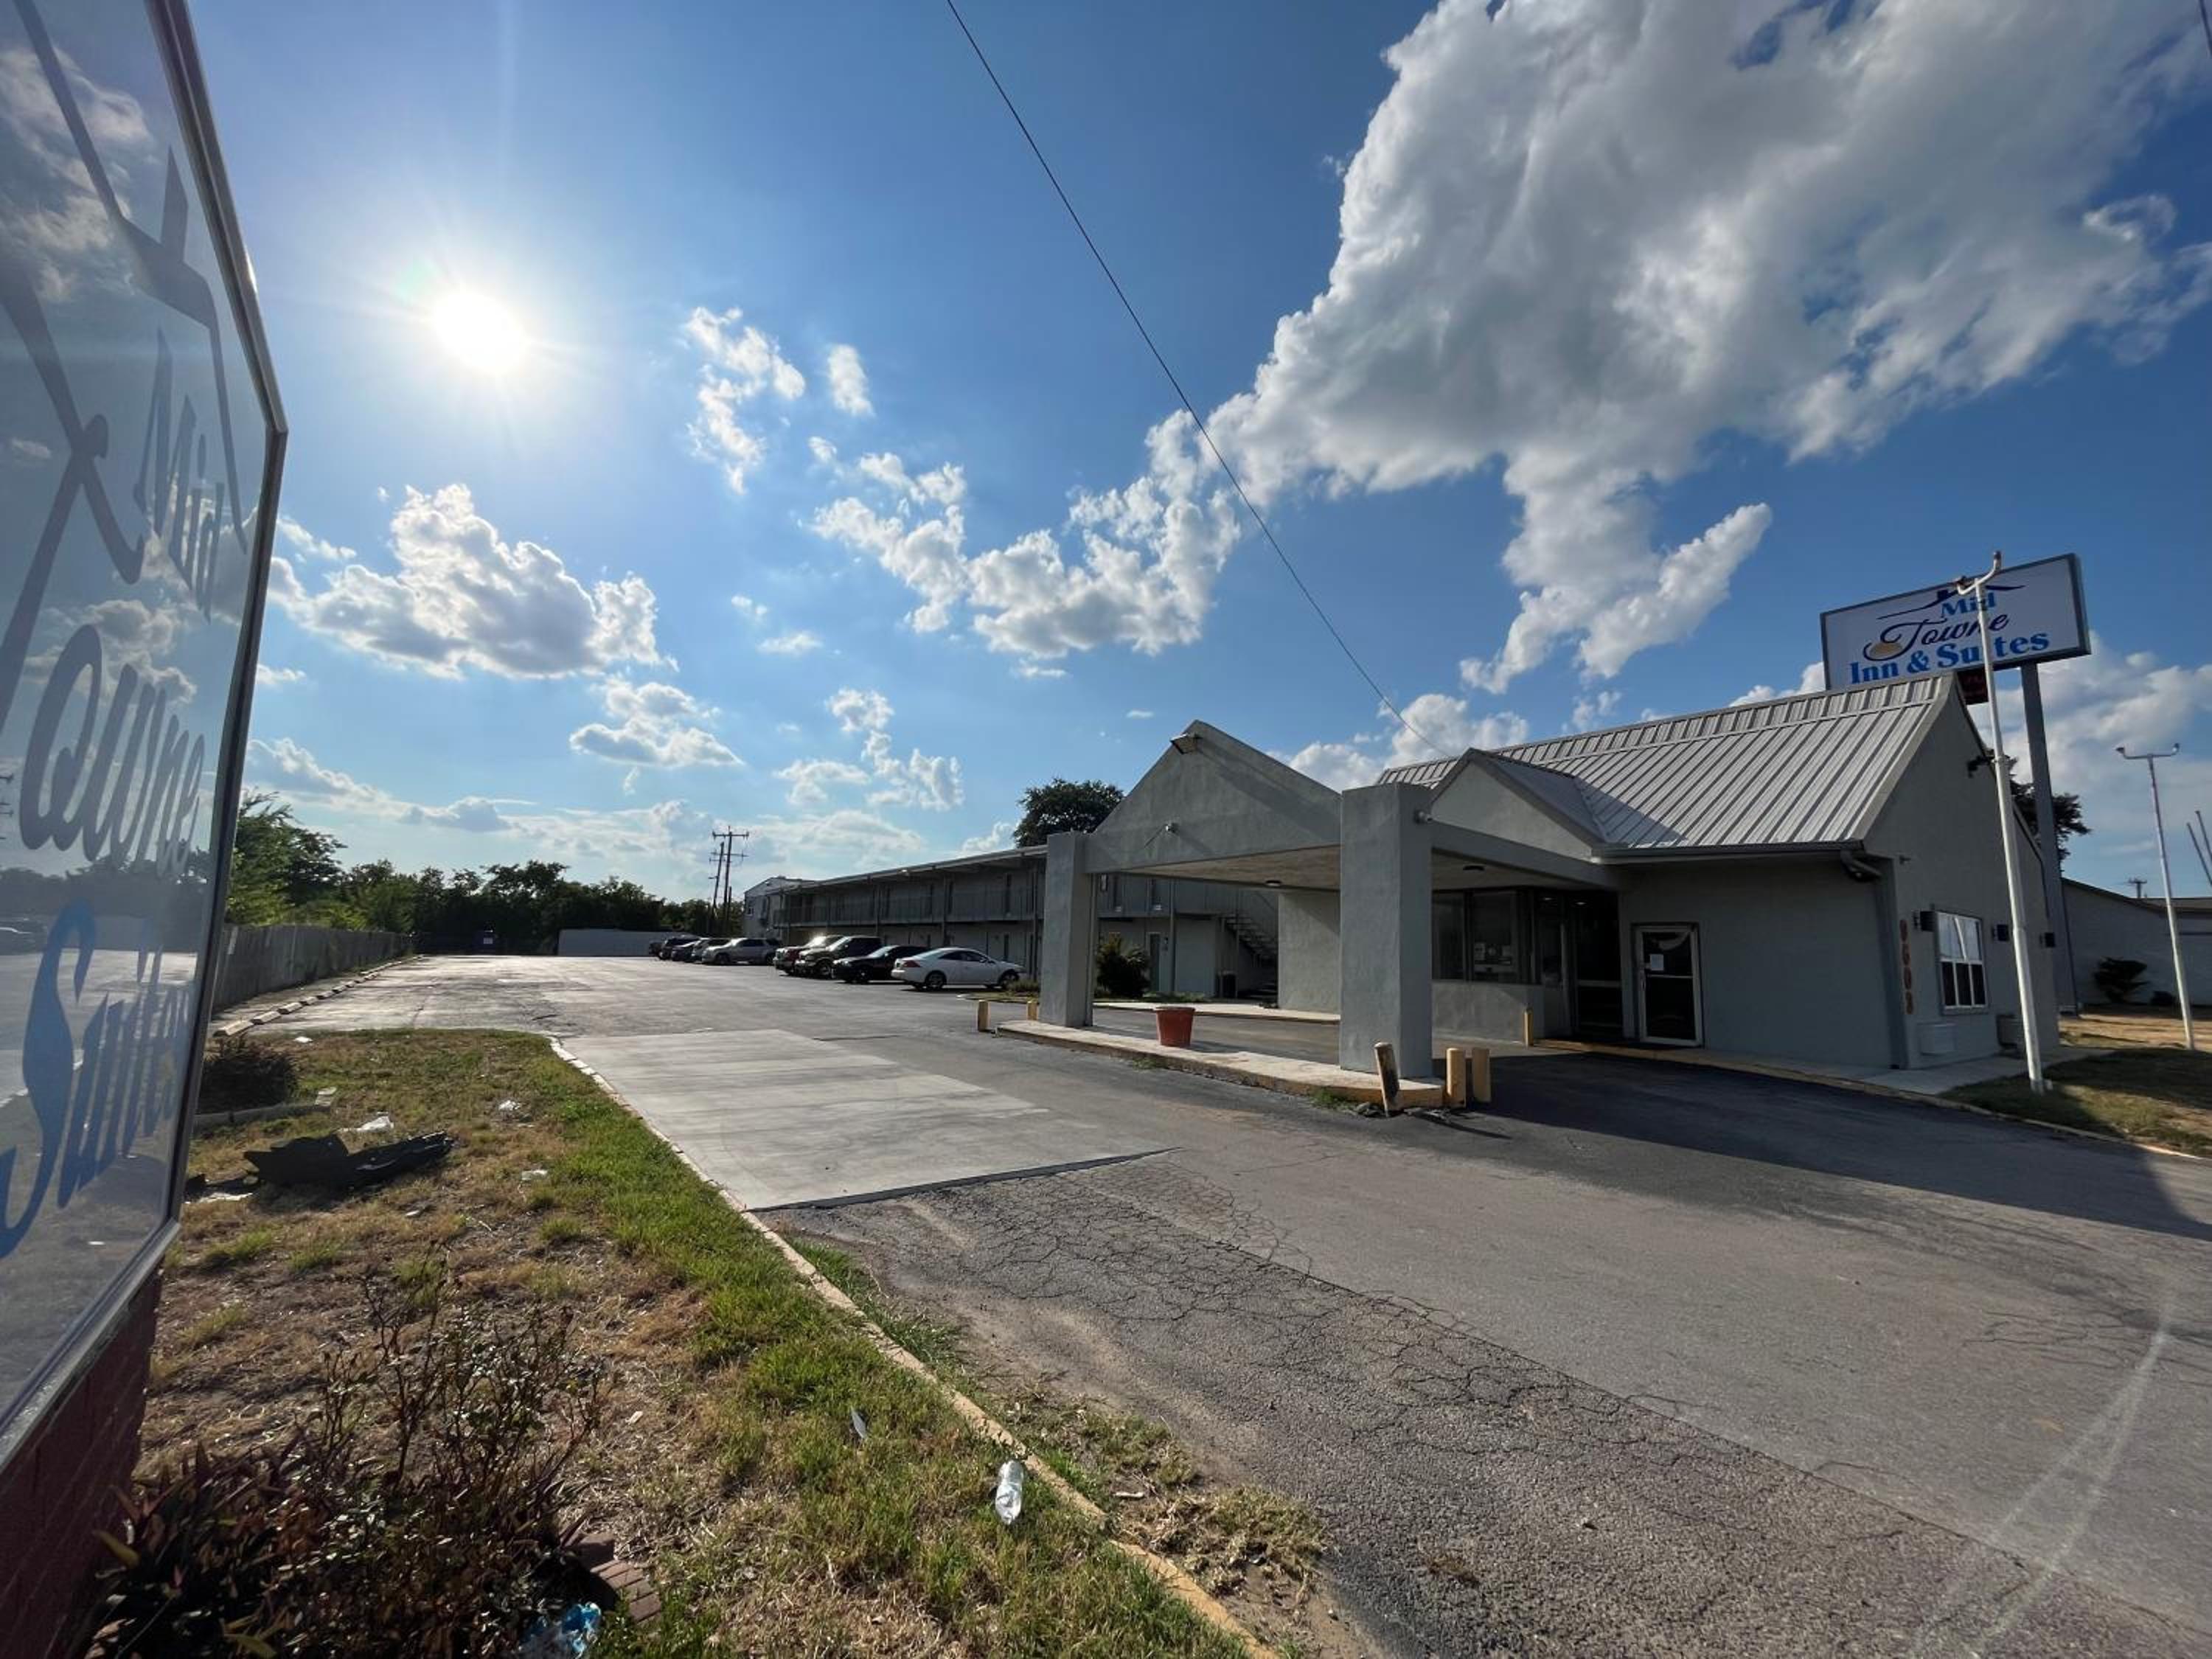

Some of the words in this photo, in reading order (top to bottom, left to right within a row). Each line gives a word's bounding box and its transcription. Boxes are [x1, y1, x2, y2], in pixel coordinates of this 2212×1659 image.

[133, 326, 224, 625] Mid
[1941, 591, 1996, 618] Mid
[1851, 661, 1900, 684] Inn
[1907, 650, 1930, 673] &
[1936, 632, 2050, 668] Sutes
